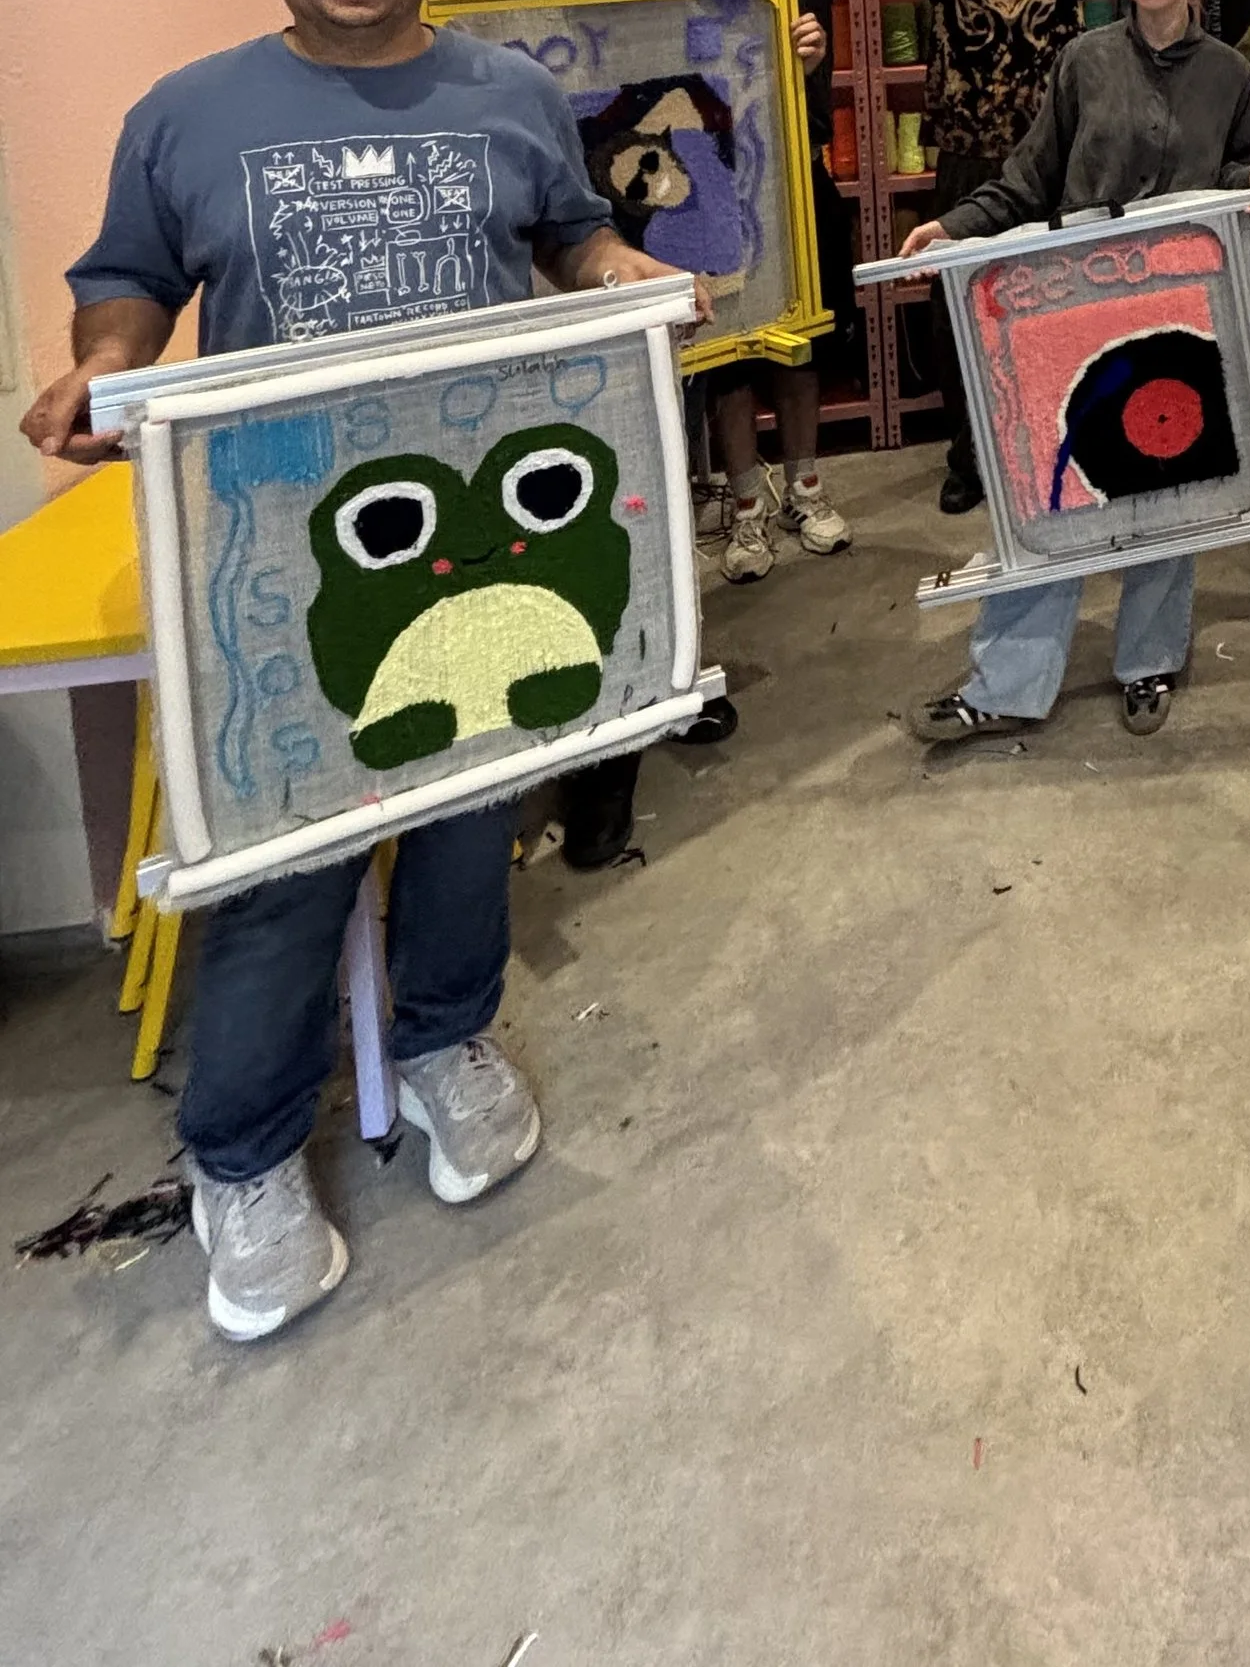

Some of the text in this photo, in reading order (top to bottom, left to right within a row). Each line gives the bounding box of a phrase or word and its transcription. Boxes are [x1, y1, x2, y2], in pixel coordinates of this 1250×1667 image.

[314, 175, 406, 191] TEST PRESSING
[320, 198, 377, 211] VERSION
[390, 194, 416, 205] ONE
[325, 208, 416, 227] VOLUME ONE
[406, 303, 448, 315] RECORD
